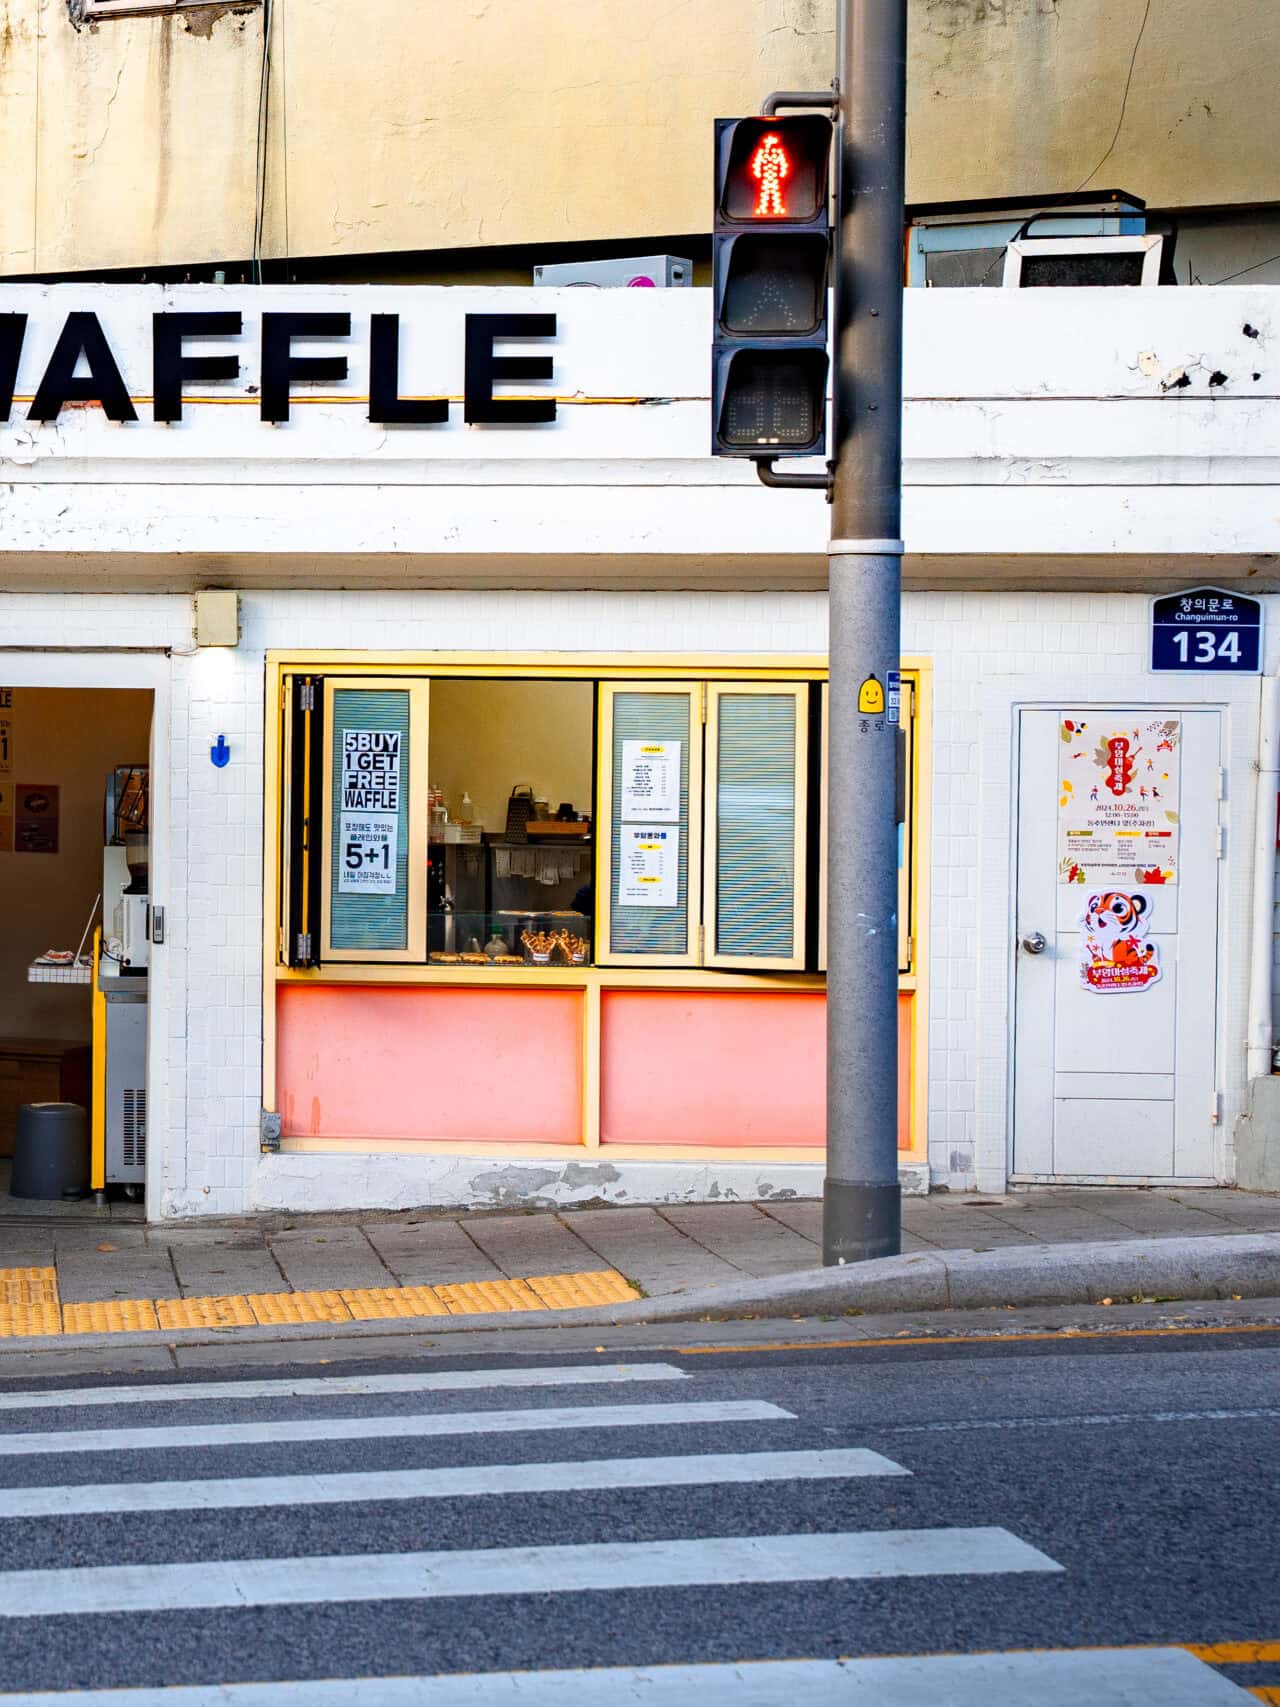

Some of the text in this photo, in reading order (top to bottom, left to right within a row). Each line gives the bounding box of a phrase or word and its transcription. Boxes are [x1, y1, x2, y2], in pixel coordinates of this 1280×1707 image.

[1180, 598, 1234, 612] 창의문로
[1175, 612, 1238, 623] Changuimun-ro
[1173, 631, 1242, 663] 134
[858, 719, 885, 733] 종로
[345, 753, 398, 770] 1 GET
[344, 771, 398, 789] FREE
[344, 790, 396, 809] WAFFLE
[345, 843, 390, 870] 5+1
